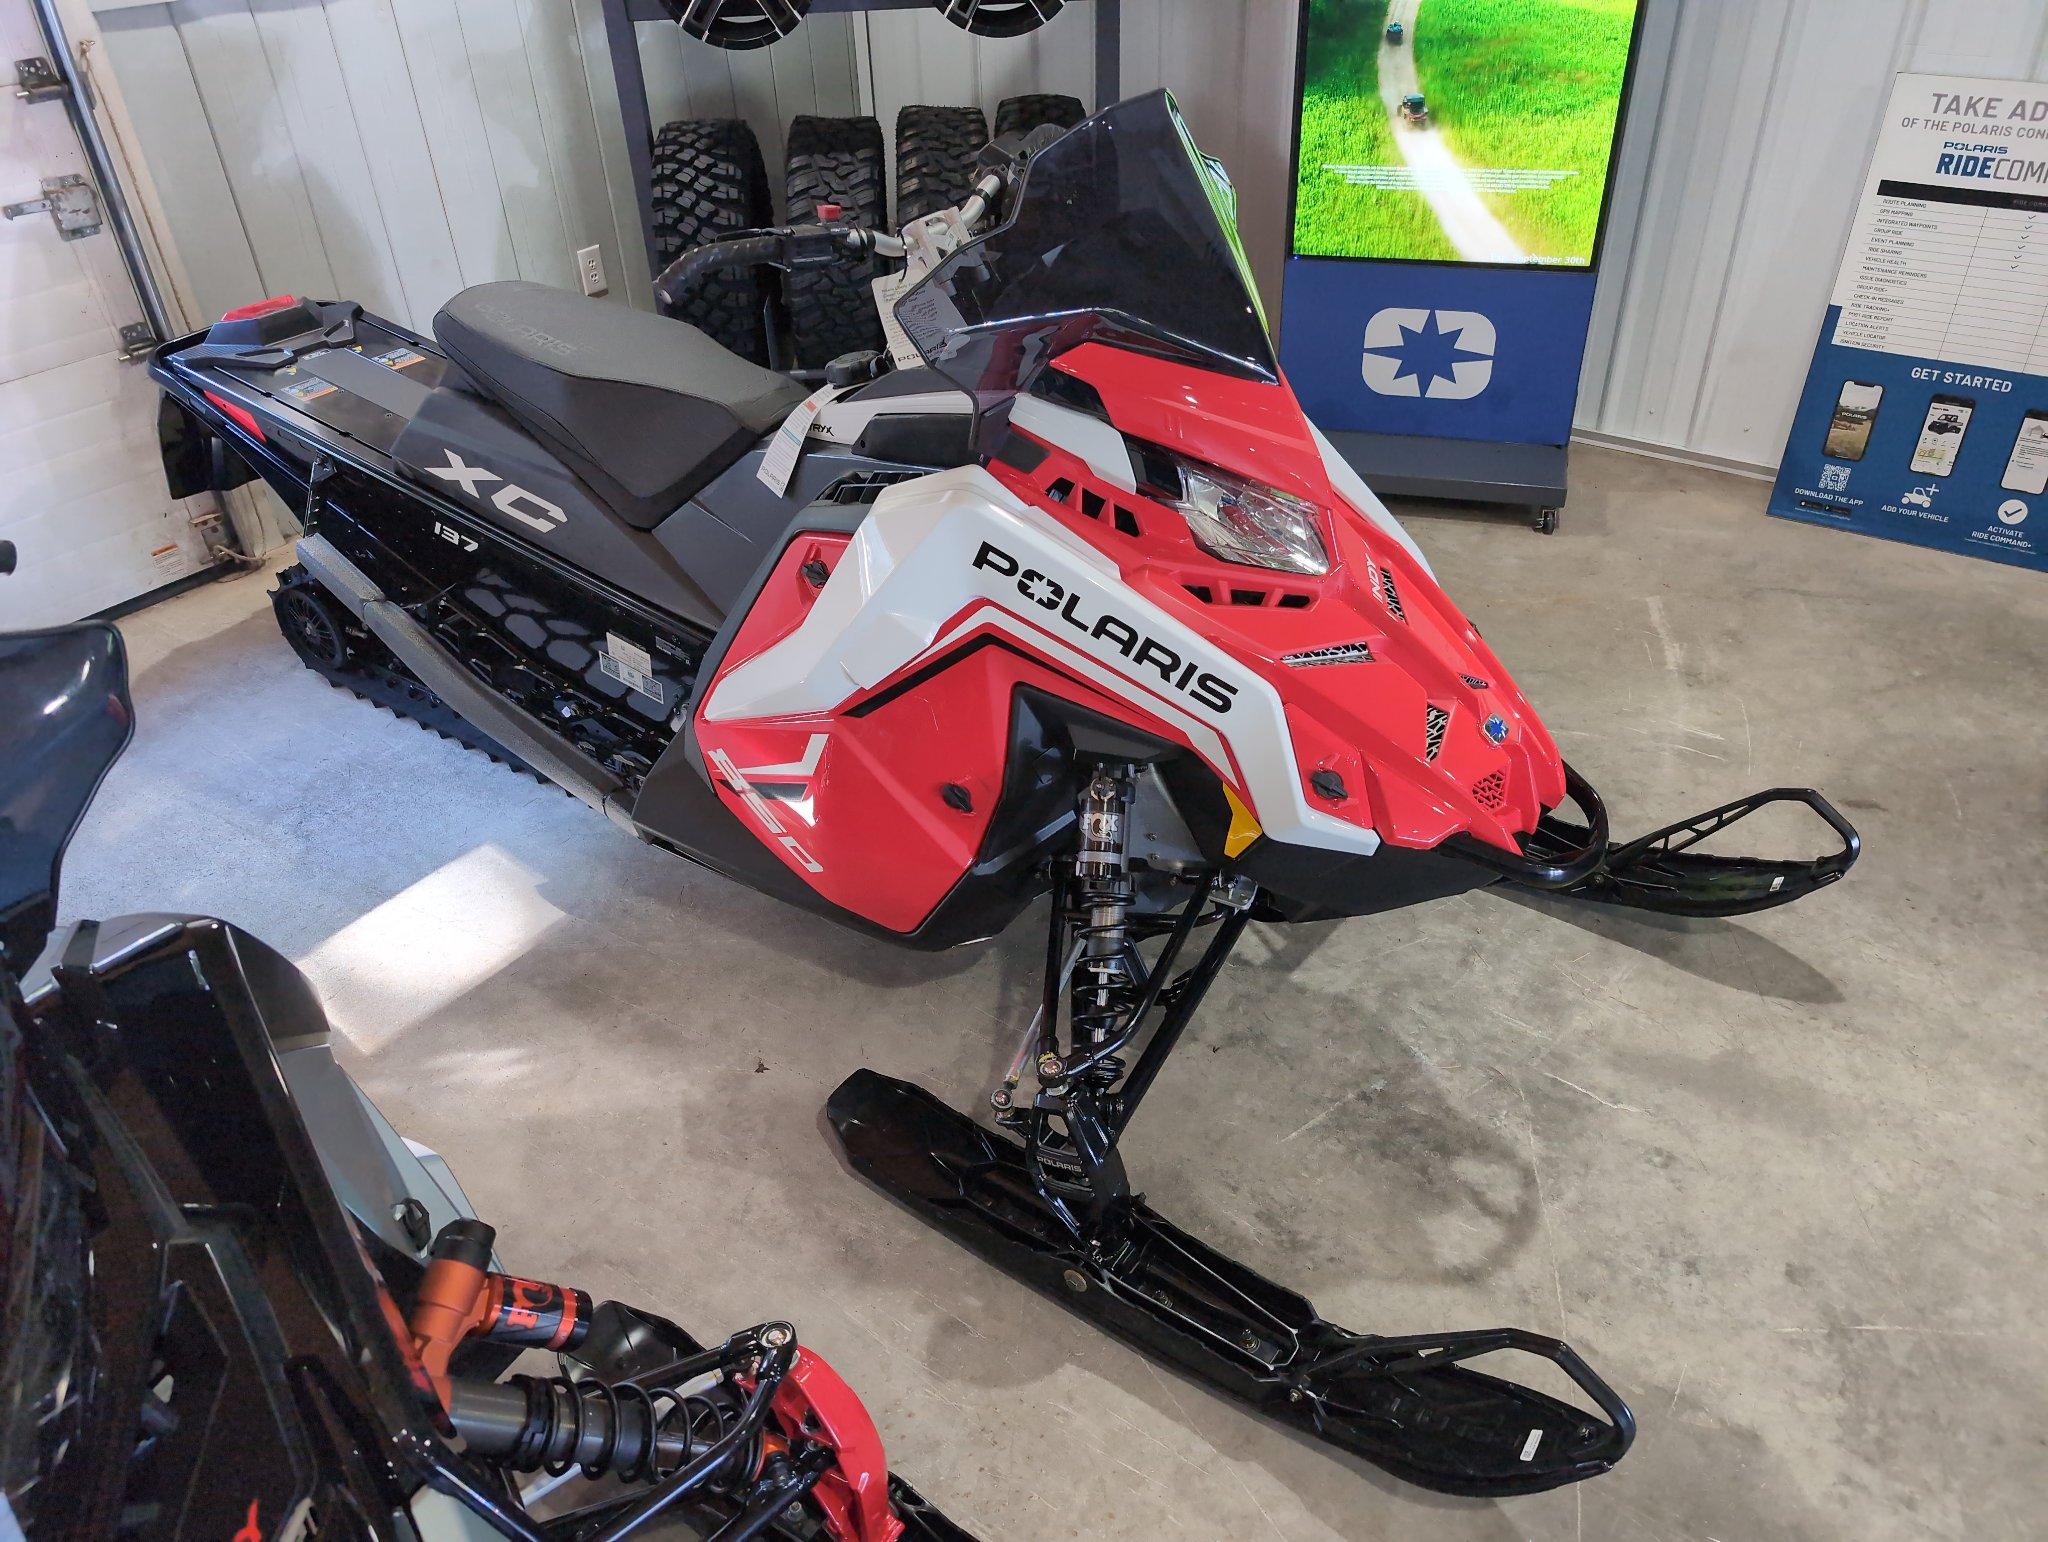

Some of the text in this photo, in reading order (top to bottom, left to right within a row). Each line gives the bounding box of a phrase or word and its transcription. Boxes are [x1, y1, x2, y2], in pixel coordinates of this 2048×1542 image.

[1932, 93, 2048, 122] TAKE AD
[1901, 117, 1920, 128] OF
[1923, 119, 1949, 132] THE
[1952, 121, 2013, 137] POLARIS
[1943, 141, 2008, 154] POLARIS
[1900, 200, 1927, 208] PLANNING
[1877, 218, 1938, 229] INTEGRATED WAYPOINTS
[1888, 239, 1915, 247] PLANNING
[1513, 254, 1561, 265] September
[1564, 256, 1585, 265] 30th
[1886, 258, 1907, 266] HEALTH
[1862, 265, 1928, 278] MAINTENANCE REMINDERS
[1911, 367, 2013, 393] GET STARTED
[423, 448, 568, 534] XC
[1794, 487, 1864, 506] DOWNLOAD THE APP
[1881, 504, 1949, 523] ADD YOUR VEHICLE
[434, 521, 479, 552] 137
[1971, 530, 1989, 540] RIDE
[1990, 534, 2032, 548] COMMAND+
[1987, 525, 2024, 538] ACTIVATE
[1365, 552, 1384, 604] INDY
[972, 540, 1239, 714] POLARIS
[707, 748, 824, 873] 850
[1082, 812, 1119, 839] FOX
[1036, 1155, 1082, 1173] POLARIS
